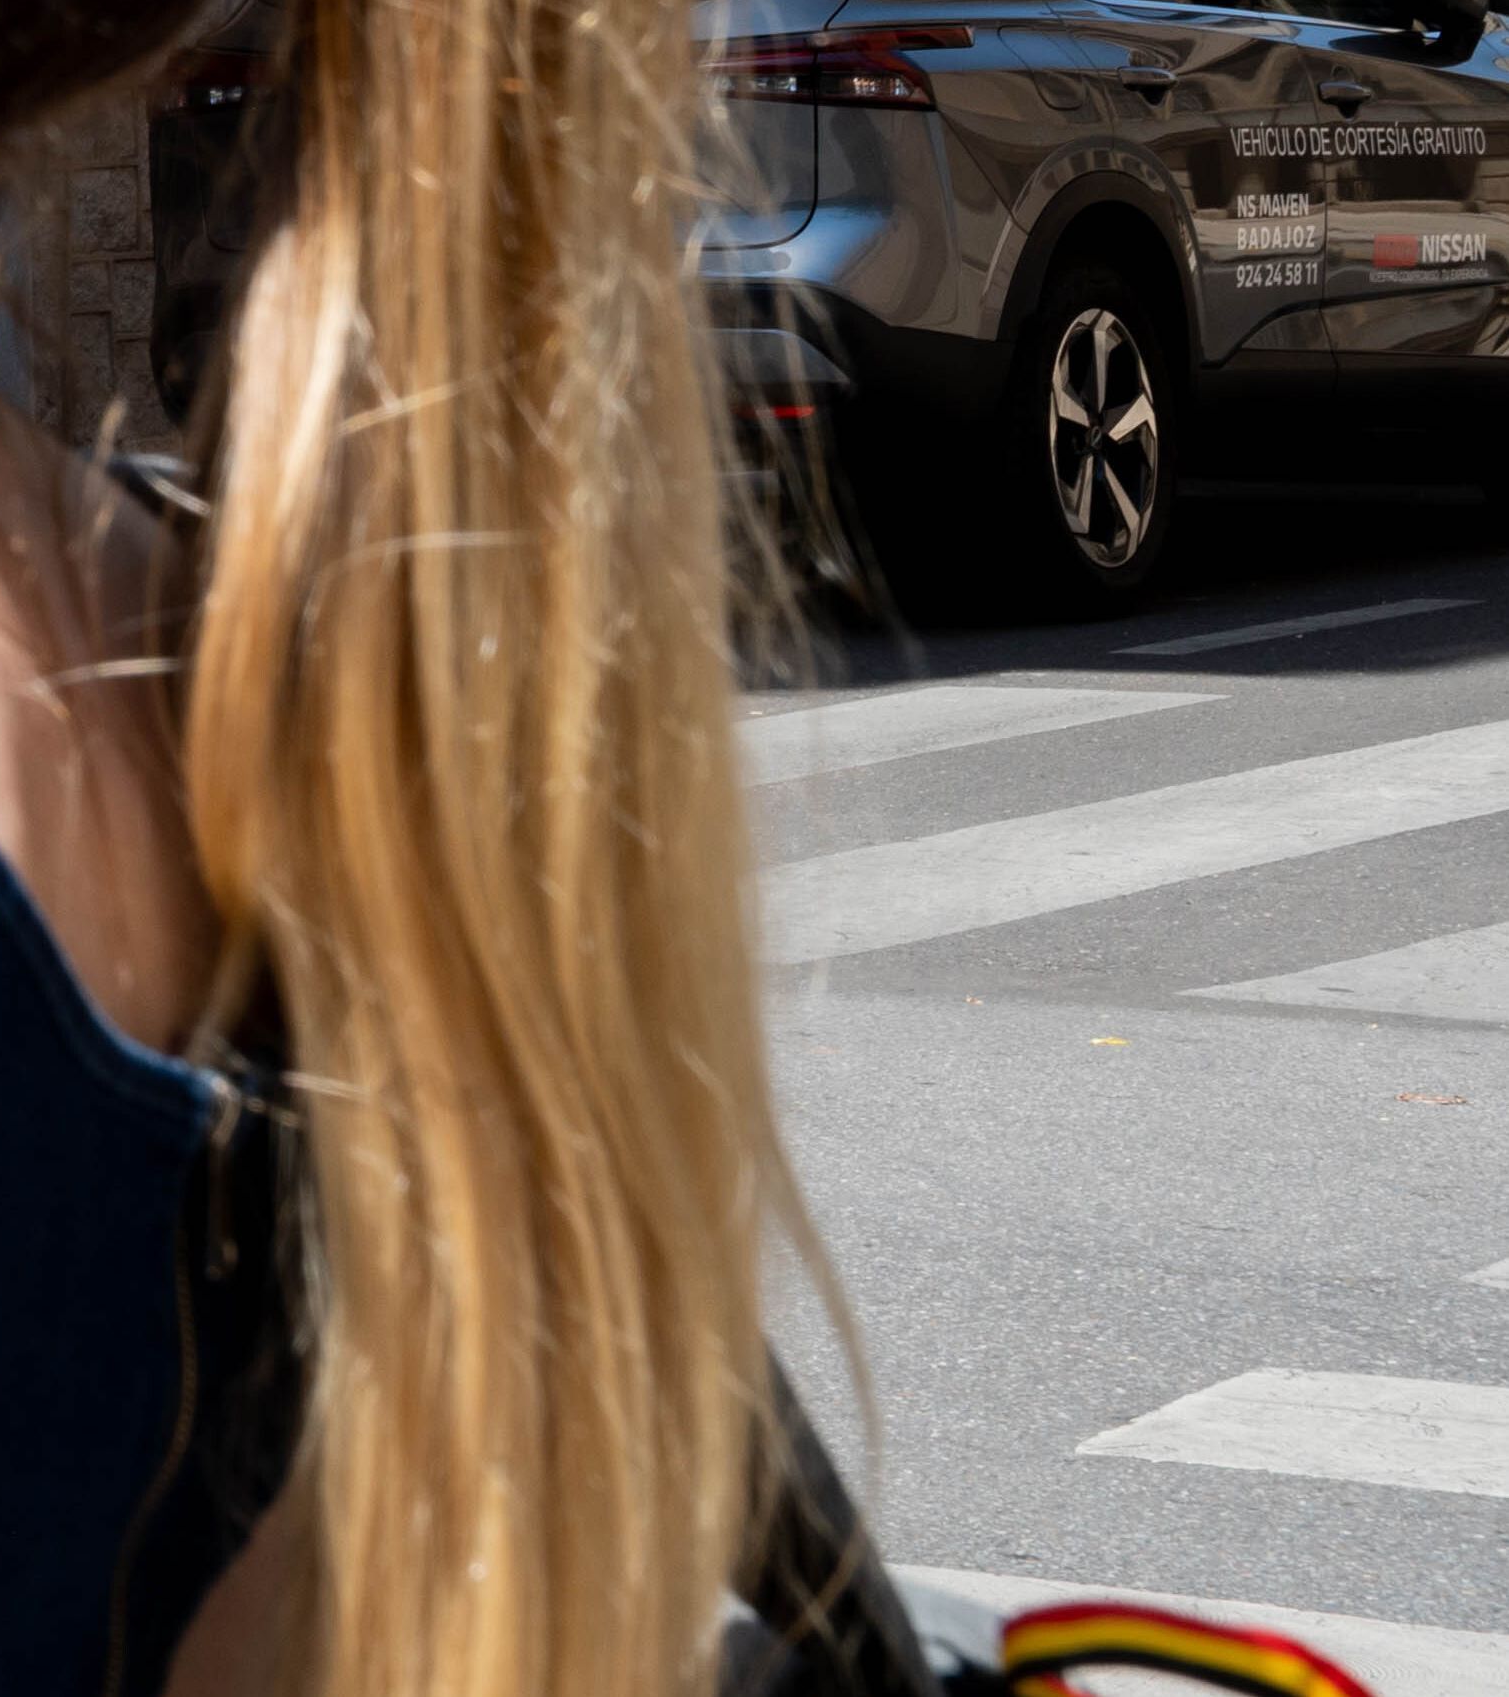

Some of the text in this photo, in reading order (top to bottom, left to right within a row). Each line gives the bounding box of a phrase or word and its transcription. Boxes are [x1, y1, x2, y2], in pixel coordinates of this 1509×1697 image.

[1231, 122, 1486, 156] VEHÍCULO DE CORTESÍA GRATUITO
[1237, 194, 1309, 218] NS MAVEN
[1237, 226, 1316, 250] BADAJOZ
[1422, 234, 1486, 263] NISSAN
[1236, 262, 1318, 288] 924 24 58 11
